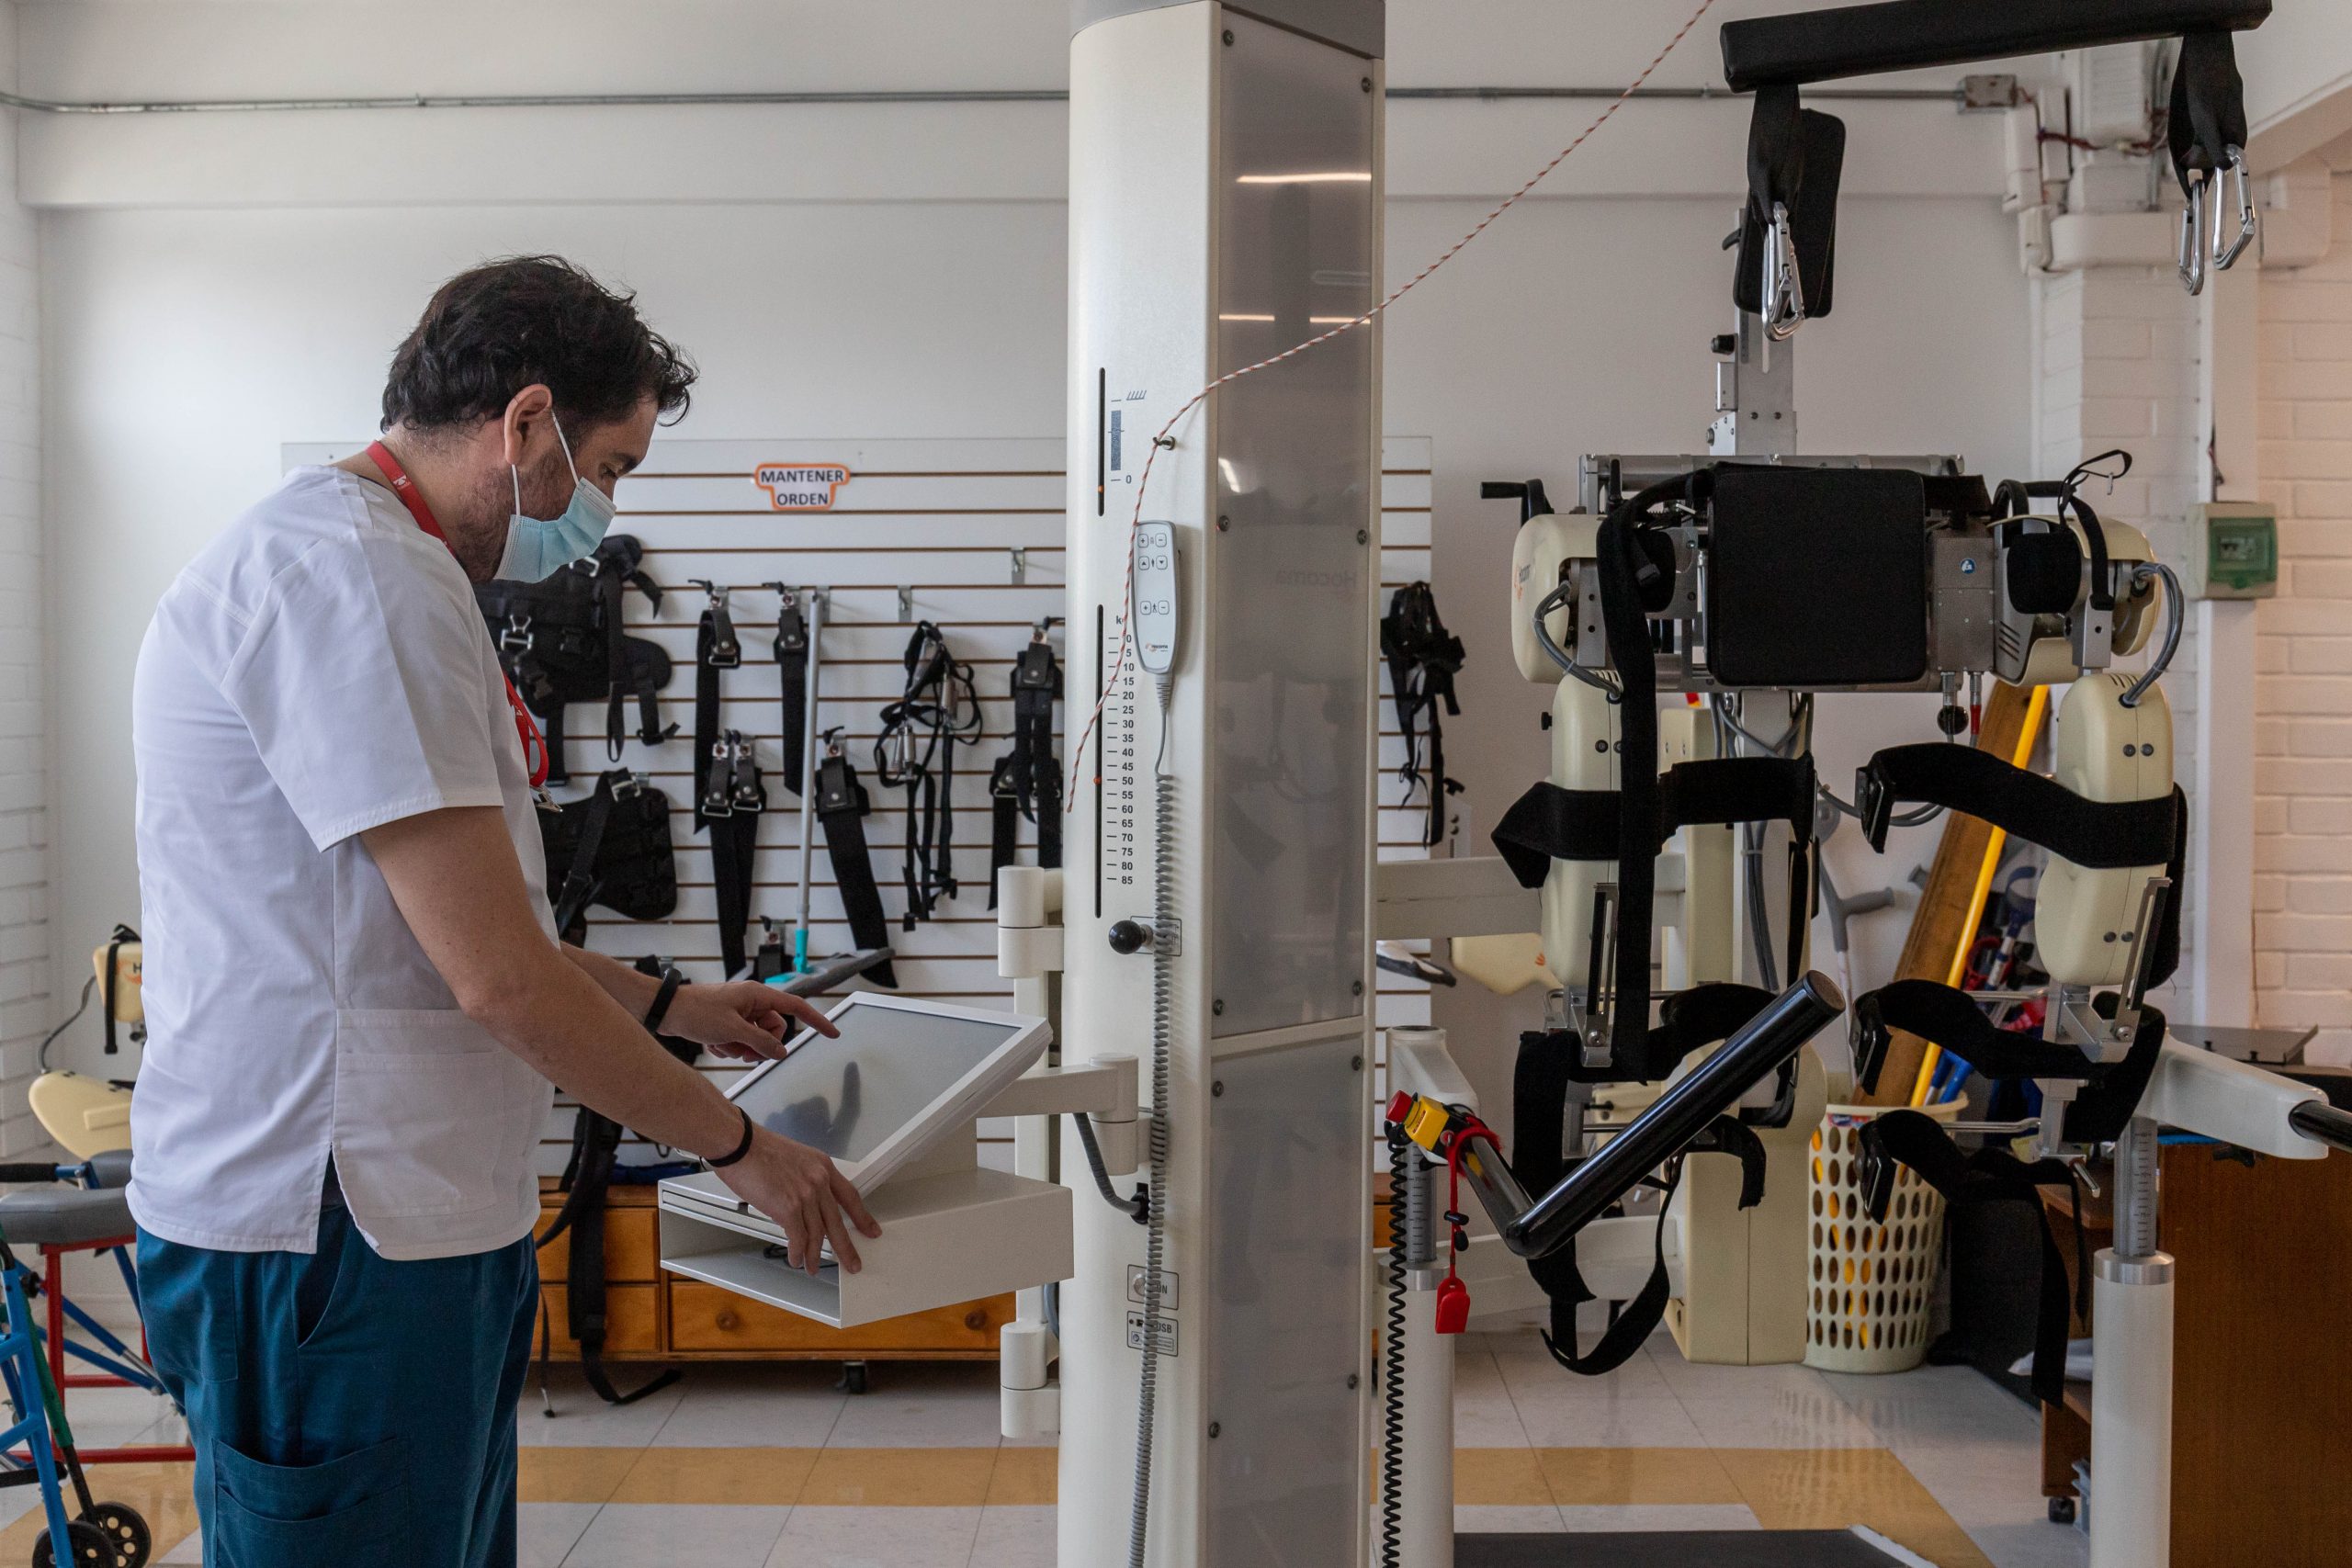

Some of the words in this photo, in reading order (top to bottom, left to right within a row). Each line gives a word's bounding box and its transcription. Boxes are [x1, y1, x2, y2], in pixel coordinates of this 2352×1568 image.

[761, 469, 844, 483] MANTENER
[1125, 474, 1133, 485] 0
[776, 492, 829, 506] ORDEN
[1125, 634, 1132, 643] 0
[1125, 649, 1132, 658] 5
[1124, 662, 1135, 671] 10
[1124, 676, 1135, 686] 15
[1123, 691, 1135, 700] 20
[1123, 705, 1135, 715] 25
[1123, 719, 1135, 728] 30
[1123, 733, 1135, 743] 35
[1123, 748, 1134, 757] 40
[1122, 761, 1134, 772] 45
[1122, 776, 1134, 785] 50
[1122, 790, 1134, 800] 55
[1122, 805, 1134, 814] 60
[1122, 818, 1134, 829] 65
[1122, 832, 1134, 842] 70
[1122, 847, 1134, 857] 75
[1122, 861, 1134, 871] 80
[1122, 875, 1134, 886] 85
